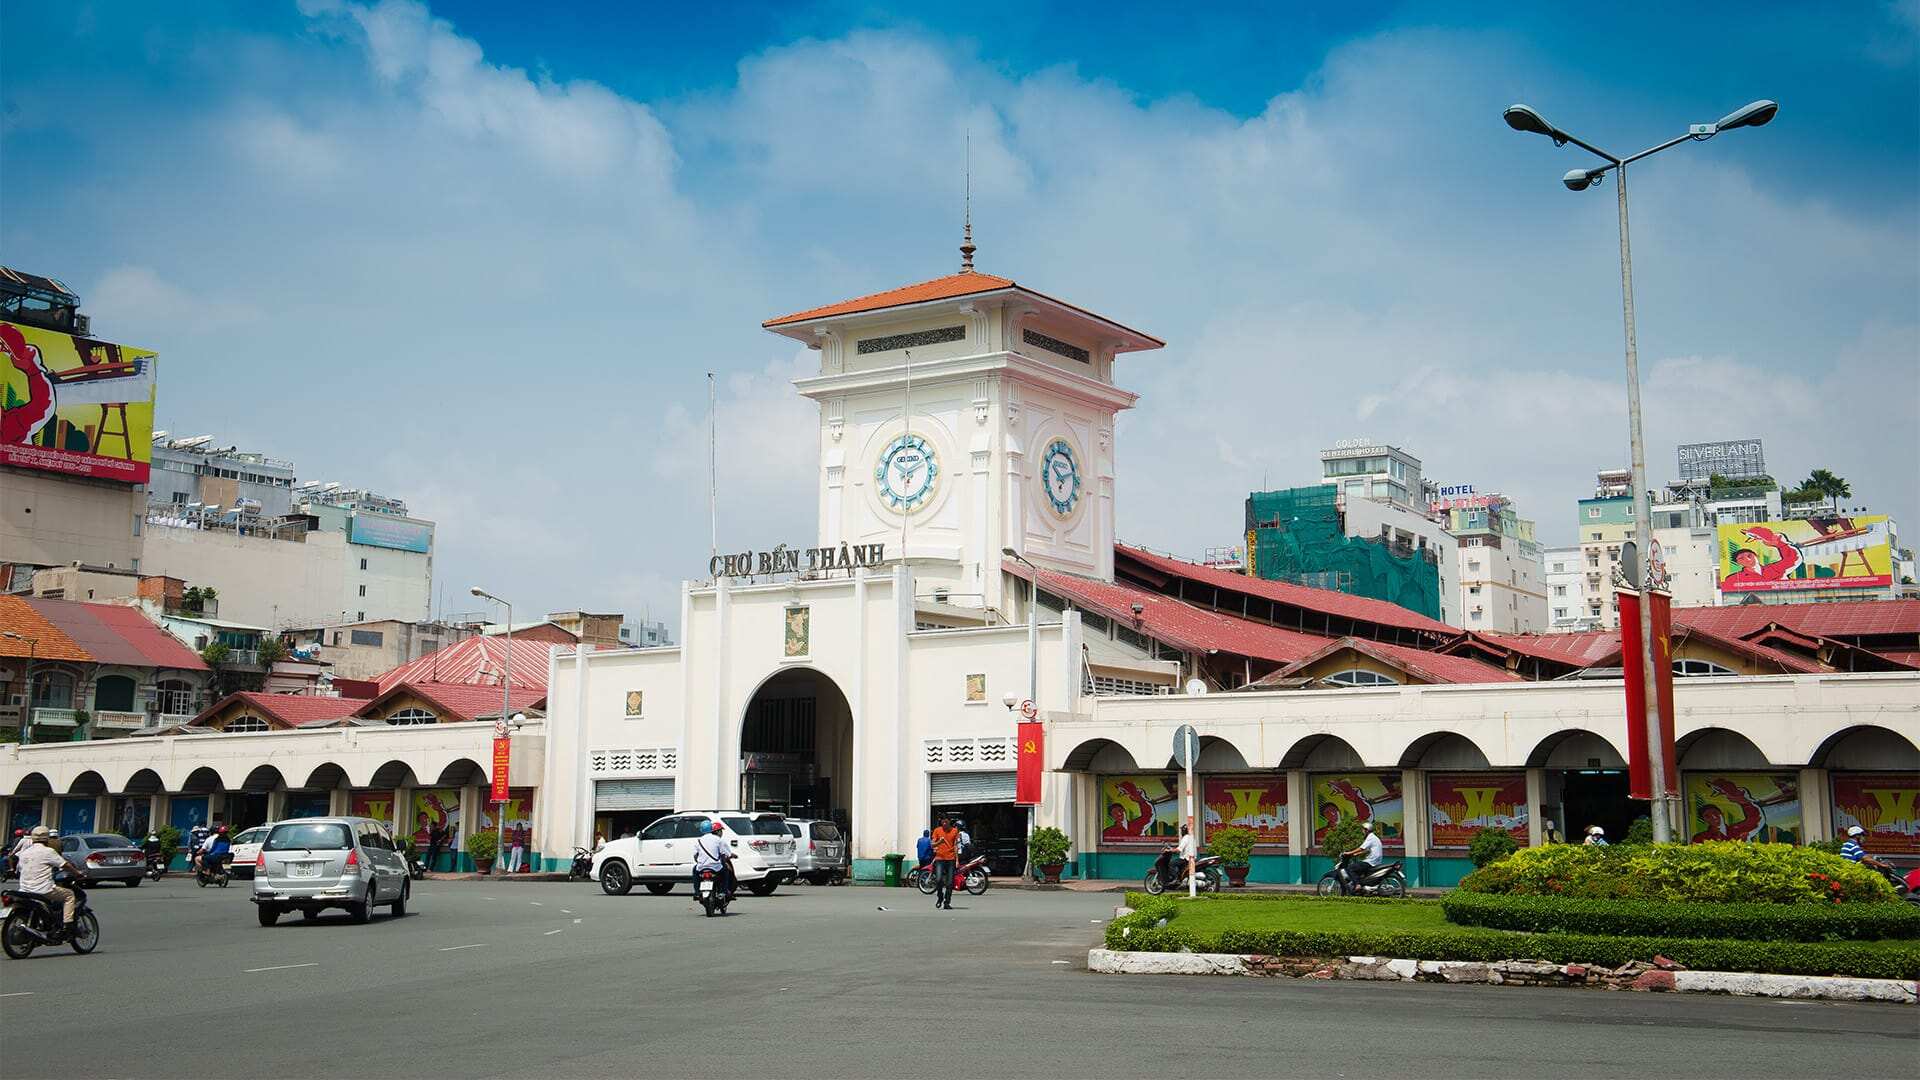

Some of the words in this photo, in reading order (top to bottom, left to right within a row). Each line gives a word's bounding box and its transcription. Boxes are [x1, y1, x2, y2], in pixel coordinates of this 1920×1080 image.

[1440, 485, 1475, 497] HOTEL
[709, 550, 753, 579] CHỢ
[758, 543, 800, 575] BẾN
[806, 541, 885, 571] THÀNH
